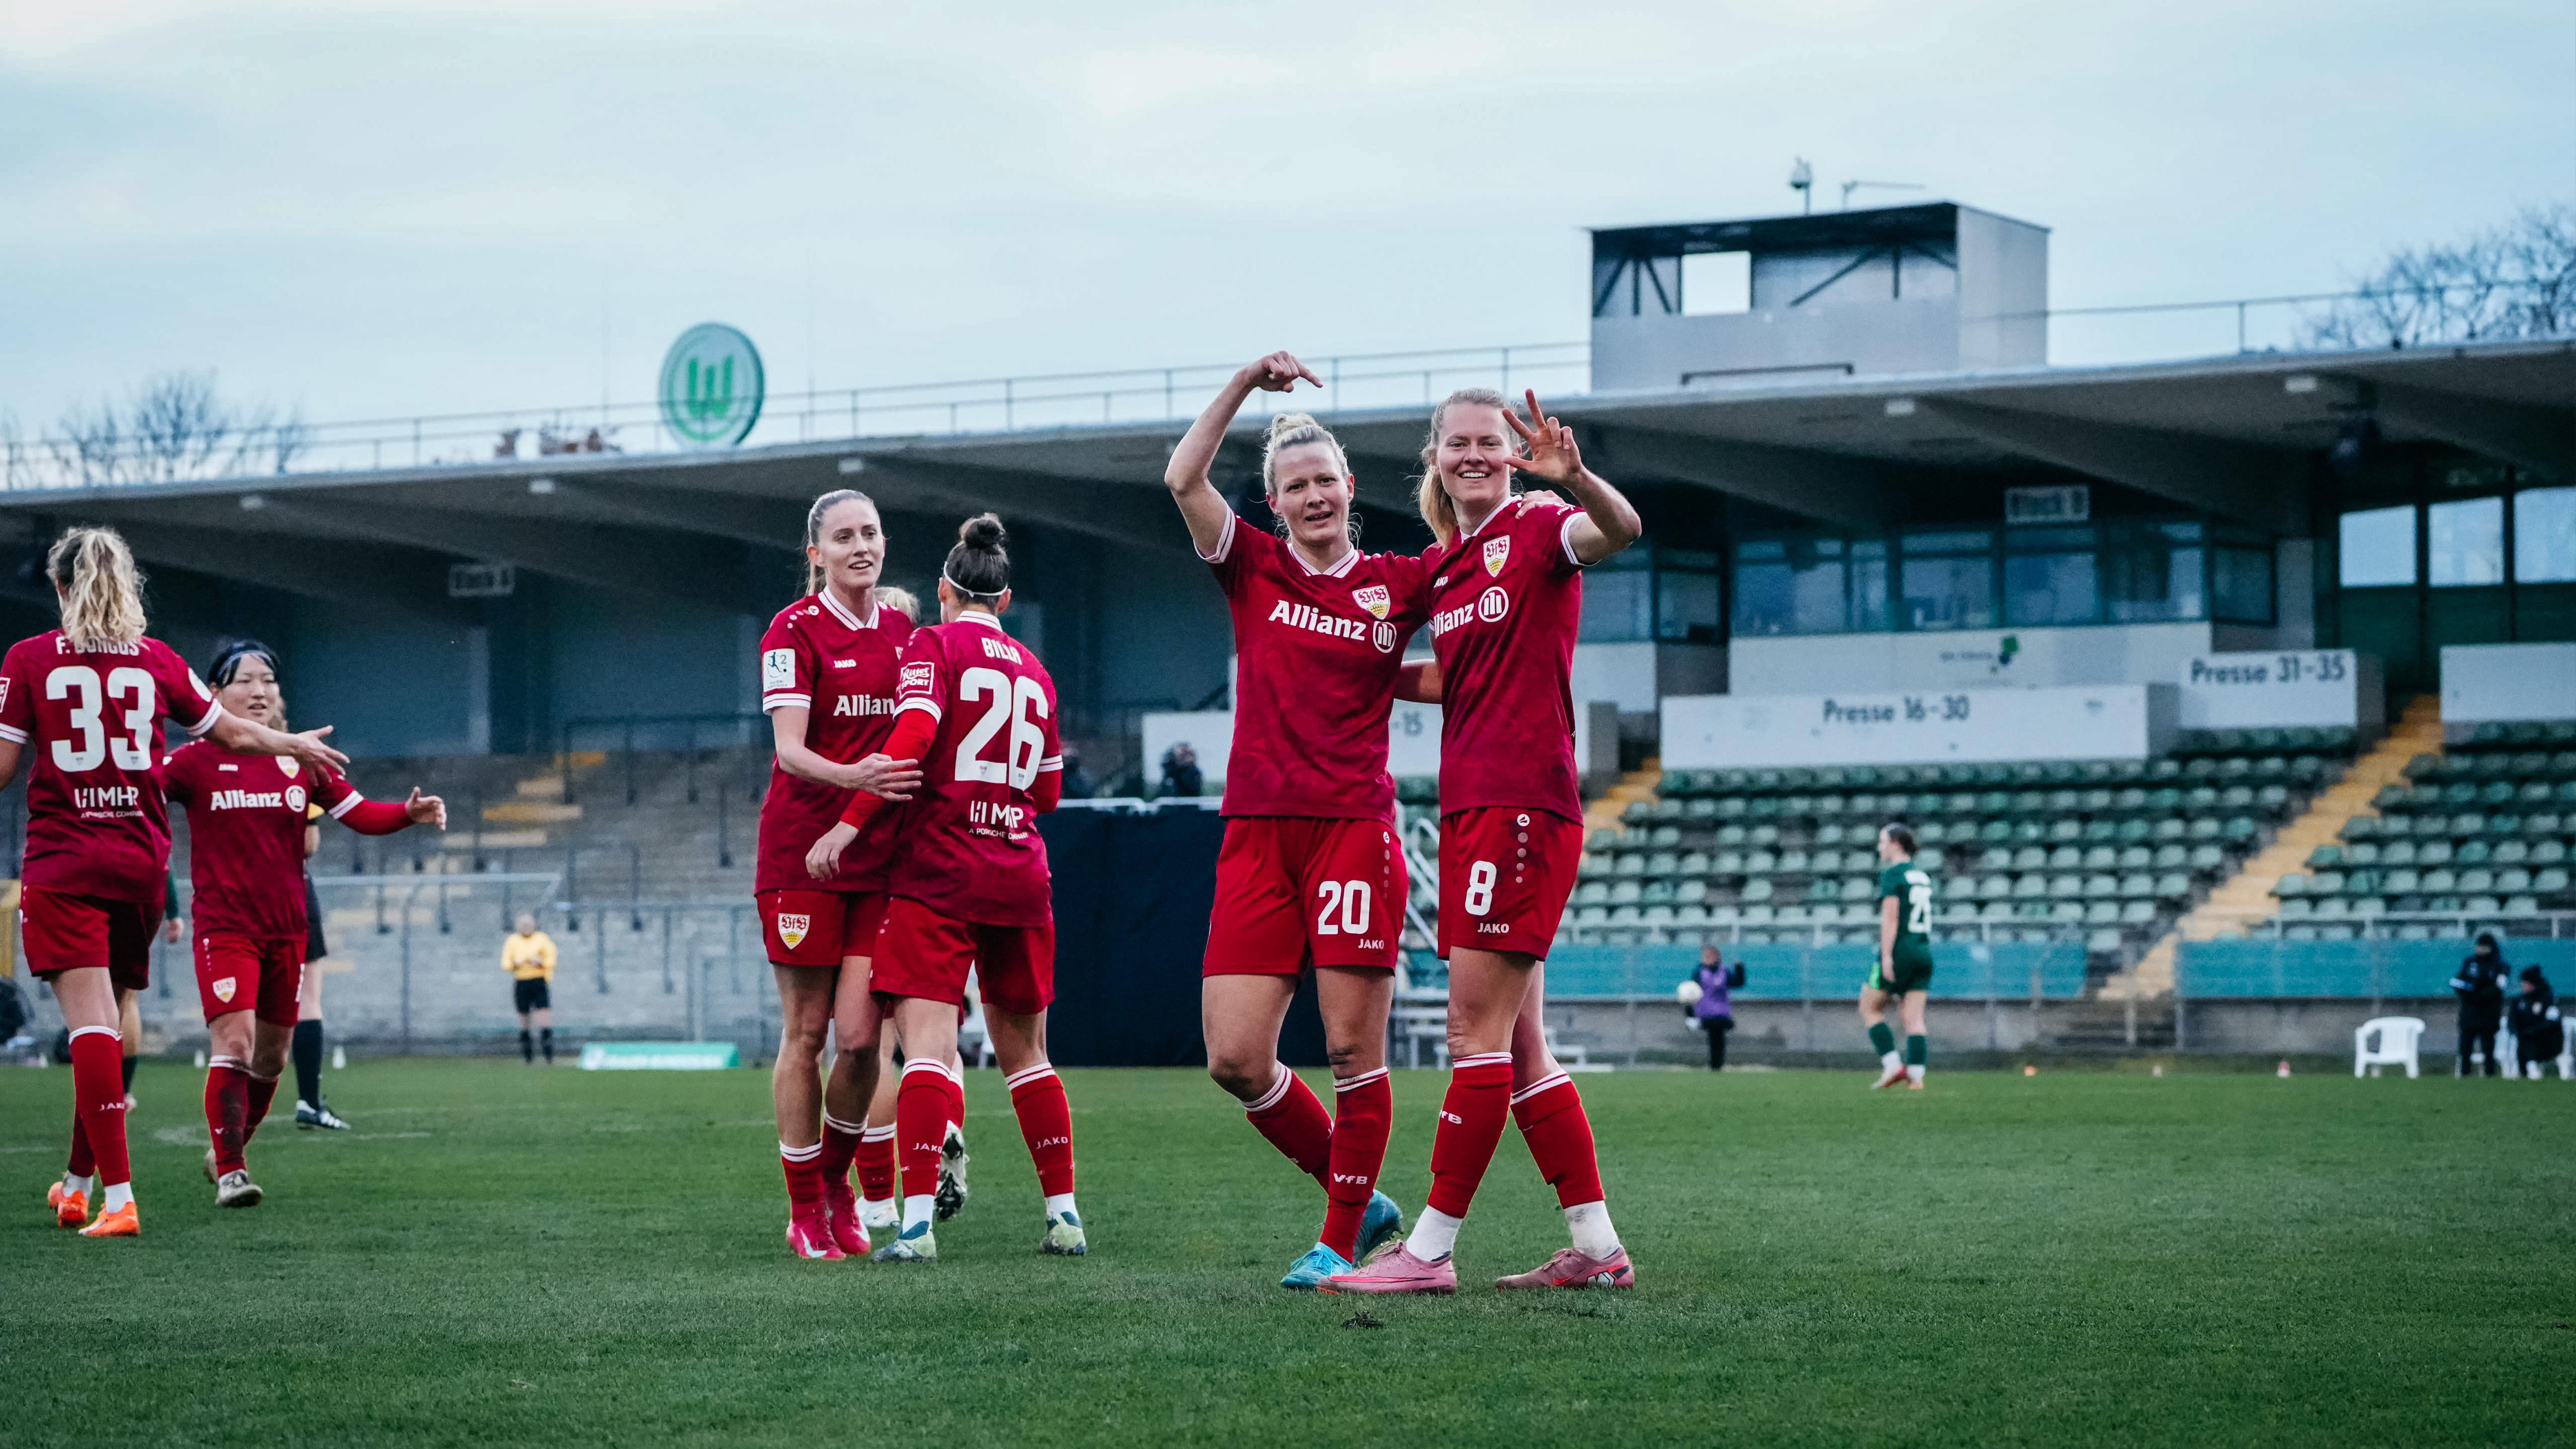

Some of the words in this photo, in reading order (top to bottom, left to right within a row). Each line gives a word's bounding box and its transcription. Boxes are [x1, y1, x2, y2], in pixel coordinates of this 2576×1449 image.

[1434, 576, 1448, 588] AKO
[1268, 599, 1366, 641] Allianz
[1434, 603, 1474, 639] llianz
[780, 654, 786, 664] 2
[834, 659, 856, 668] JAKO
[902, 667, 930, 681] Ritter
[2191, 658, 2267, 684] Presse
[2277, 655, 2346, 682] 31-35
[833, 694, 895, 716] Allian
[1823, 698, 1894, 723] Presse
[1904, 695, 1970, 721] 16-30
[46, 666, 155, 772] 33
[955, 667, 1048, 791] 26
[210, 790, 283, 811] Allianz
[976, 828, 1006, 838] PORSCHE
[1465, 860, 1497, 916] 8
[1318, 880, 1371, 934] 20
[1478, 923, 1509, 934] JAKO
[1358, 939, 1384, 950] JAKO
[912, 1143, 942, 1154] JAKO
[1036, 1137, 1068, 1149] JAKO
[1334, 1173, 1367, 1185] VfB
